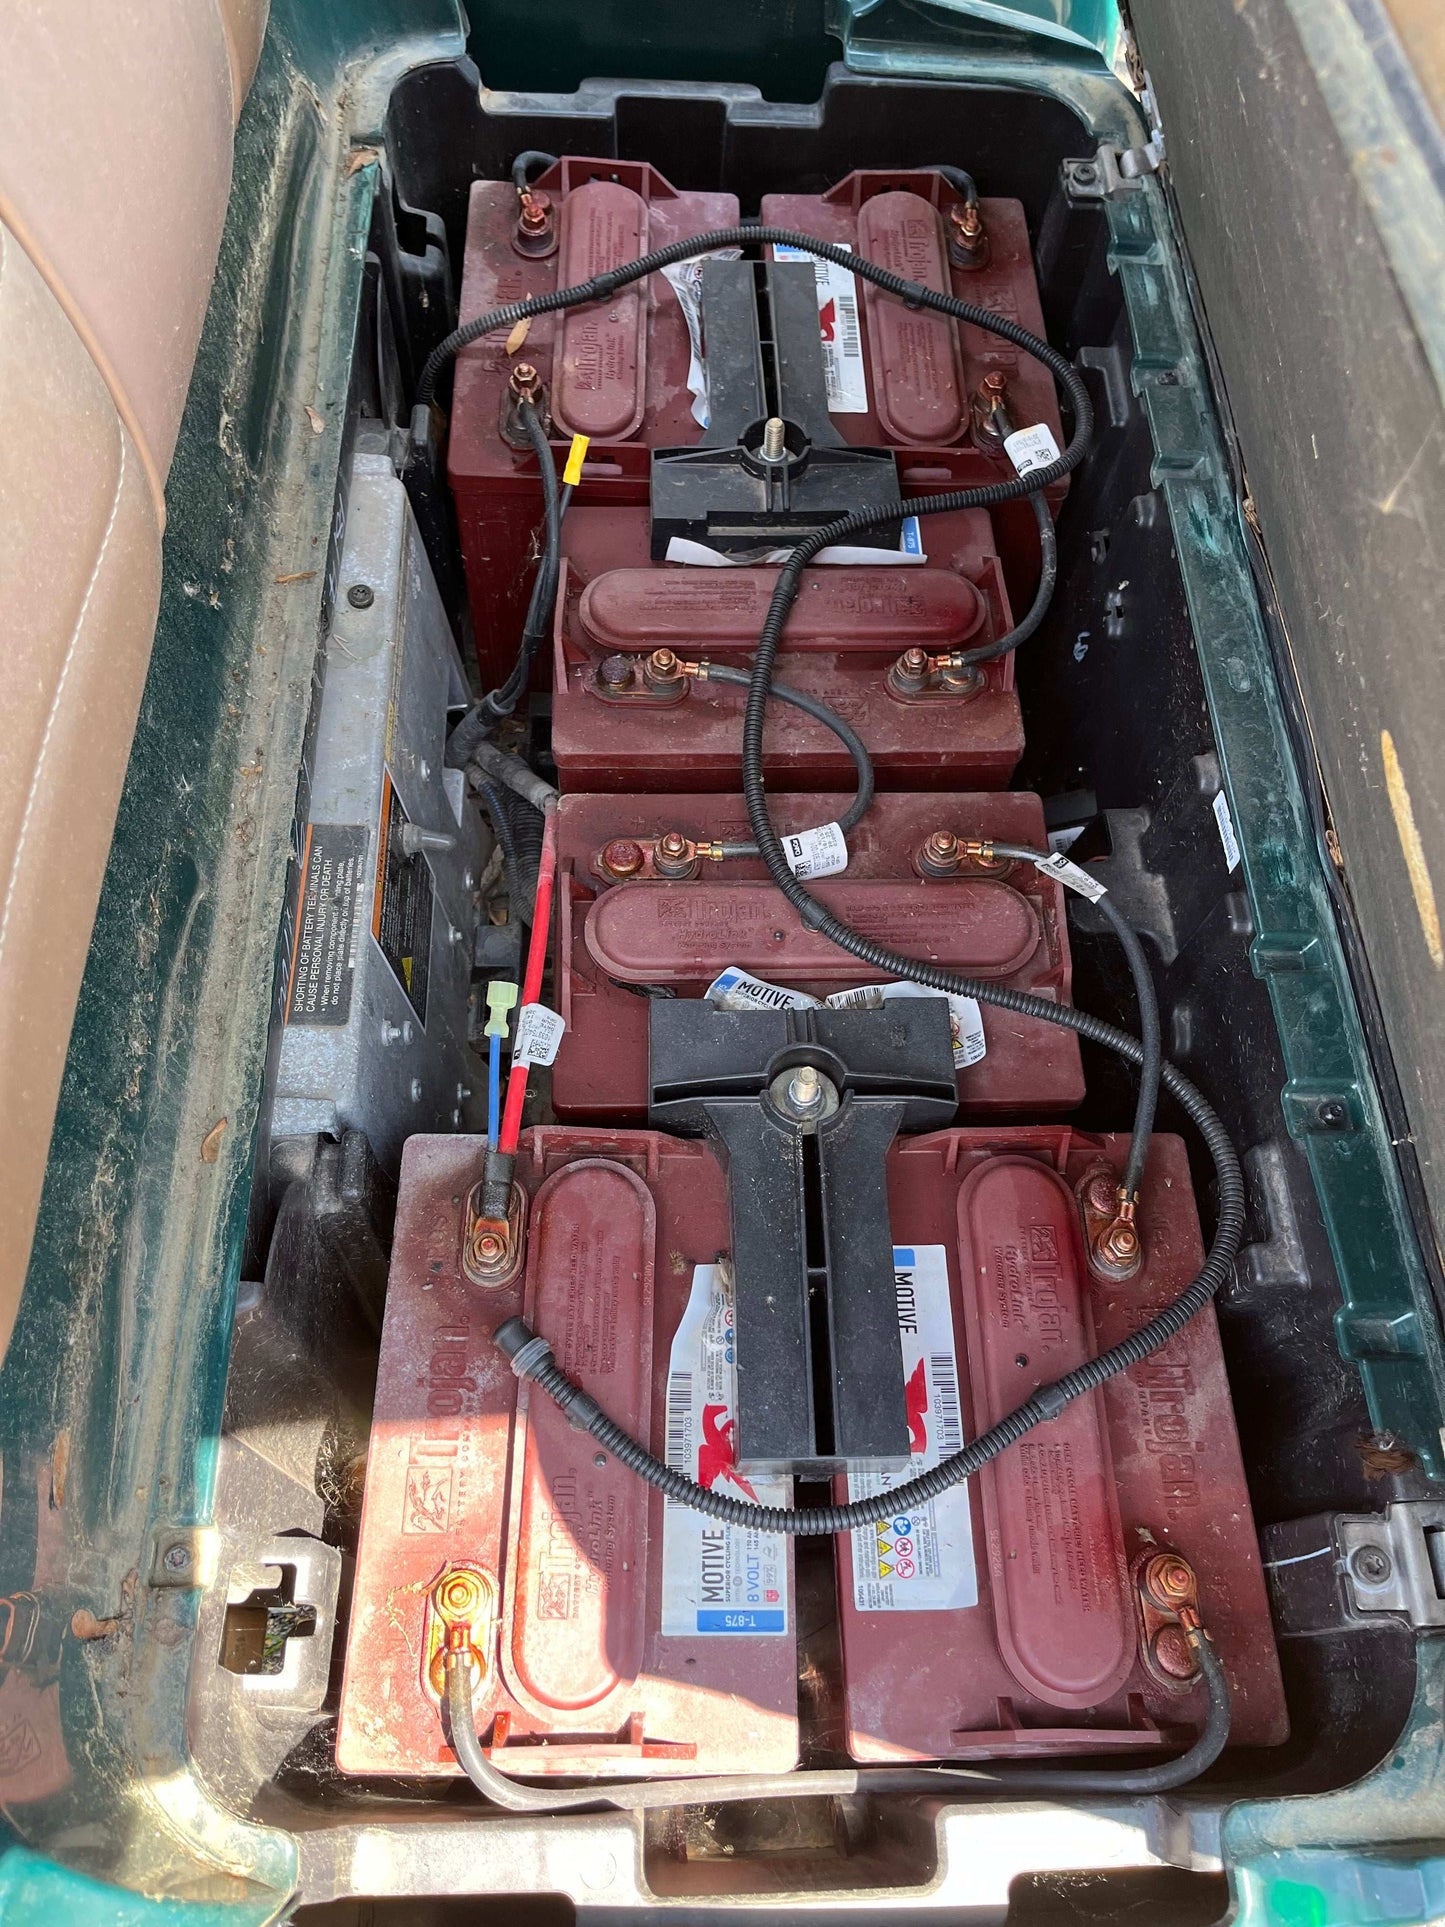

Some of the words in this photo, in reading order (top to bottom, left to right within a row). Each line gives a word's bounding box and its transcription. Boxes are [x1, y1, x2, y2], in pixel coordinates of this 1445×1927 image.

[314, 846, 323, 863] CAN
[320, 888, 329, 900] OR
[302, 913, 315, 950] BATTERY
[317, 904, 327, 931] INJURY
[329, 912, 339, 949] component
[338, 918, 349, 942] directly
[300, 952, 309, 964] OF
[310, 933, 323, 980] PERSONAL
[324, 951, 335, 983] removing
[333, 962, 342, 981] place
[294, 966, 308, 1012] SHORTING
[306, 982, 318, 1012] CAUSE
[320, 985, 330, 1005] When
[331, 996, 338, 1005] do
[738, 981, 794, 1009] MOTIVE
[571, 1224, 579, 1251] WATER
[1032, 1263, 1067, 1343] Trojan
[933, 1394, 944, 1440] 103971703
[683, 1417, 692, 1463] 103971703
[1145, 1368, 1208, 1509] Trojan
[538, 1475, 582, 1573] Trojan
[606, 1495, 616, 1538] System
[604, 1540, 616, 1593] Watering
[701, 1530, 724, 1602] MOTIVE
[747, 1554, 759, 1591] VOLT
[766, 1566, 774, 1584] 99%
[747, 1594, 759, 1602] 8
[1080, 1578, 1091, 1613] WATER
[725, 1615, 756, 1627] T-875
